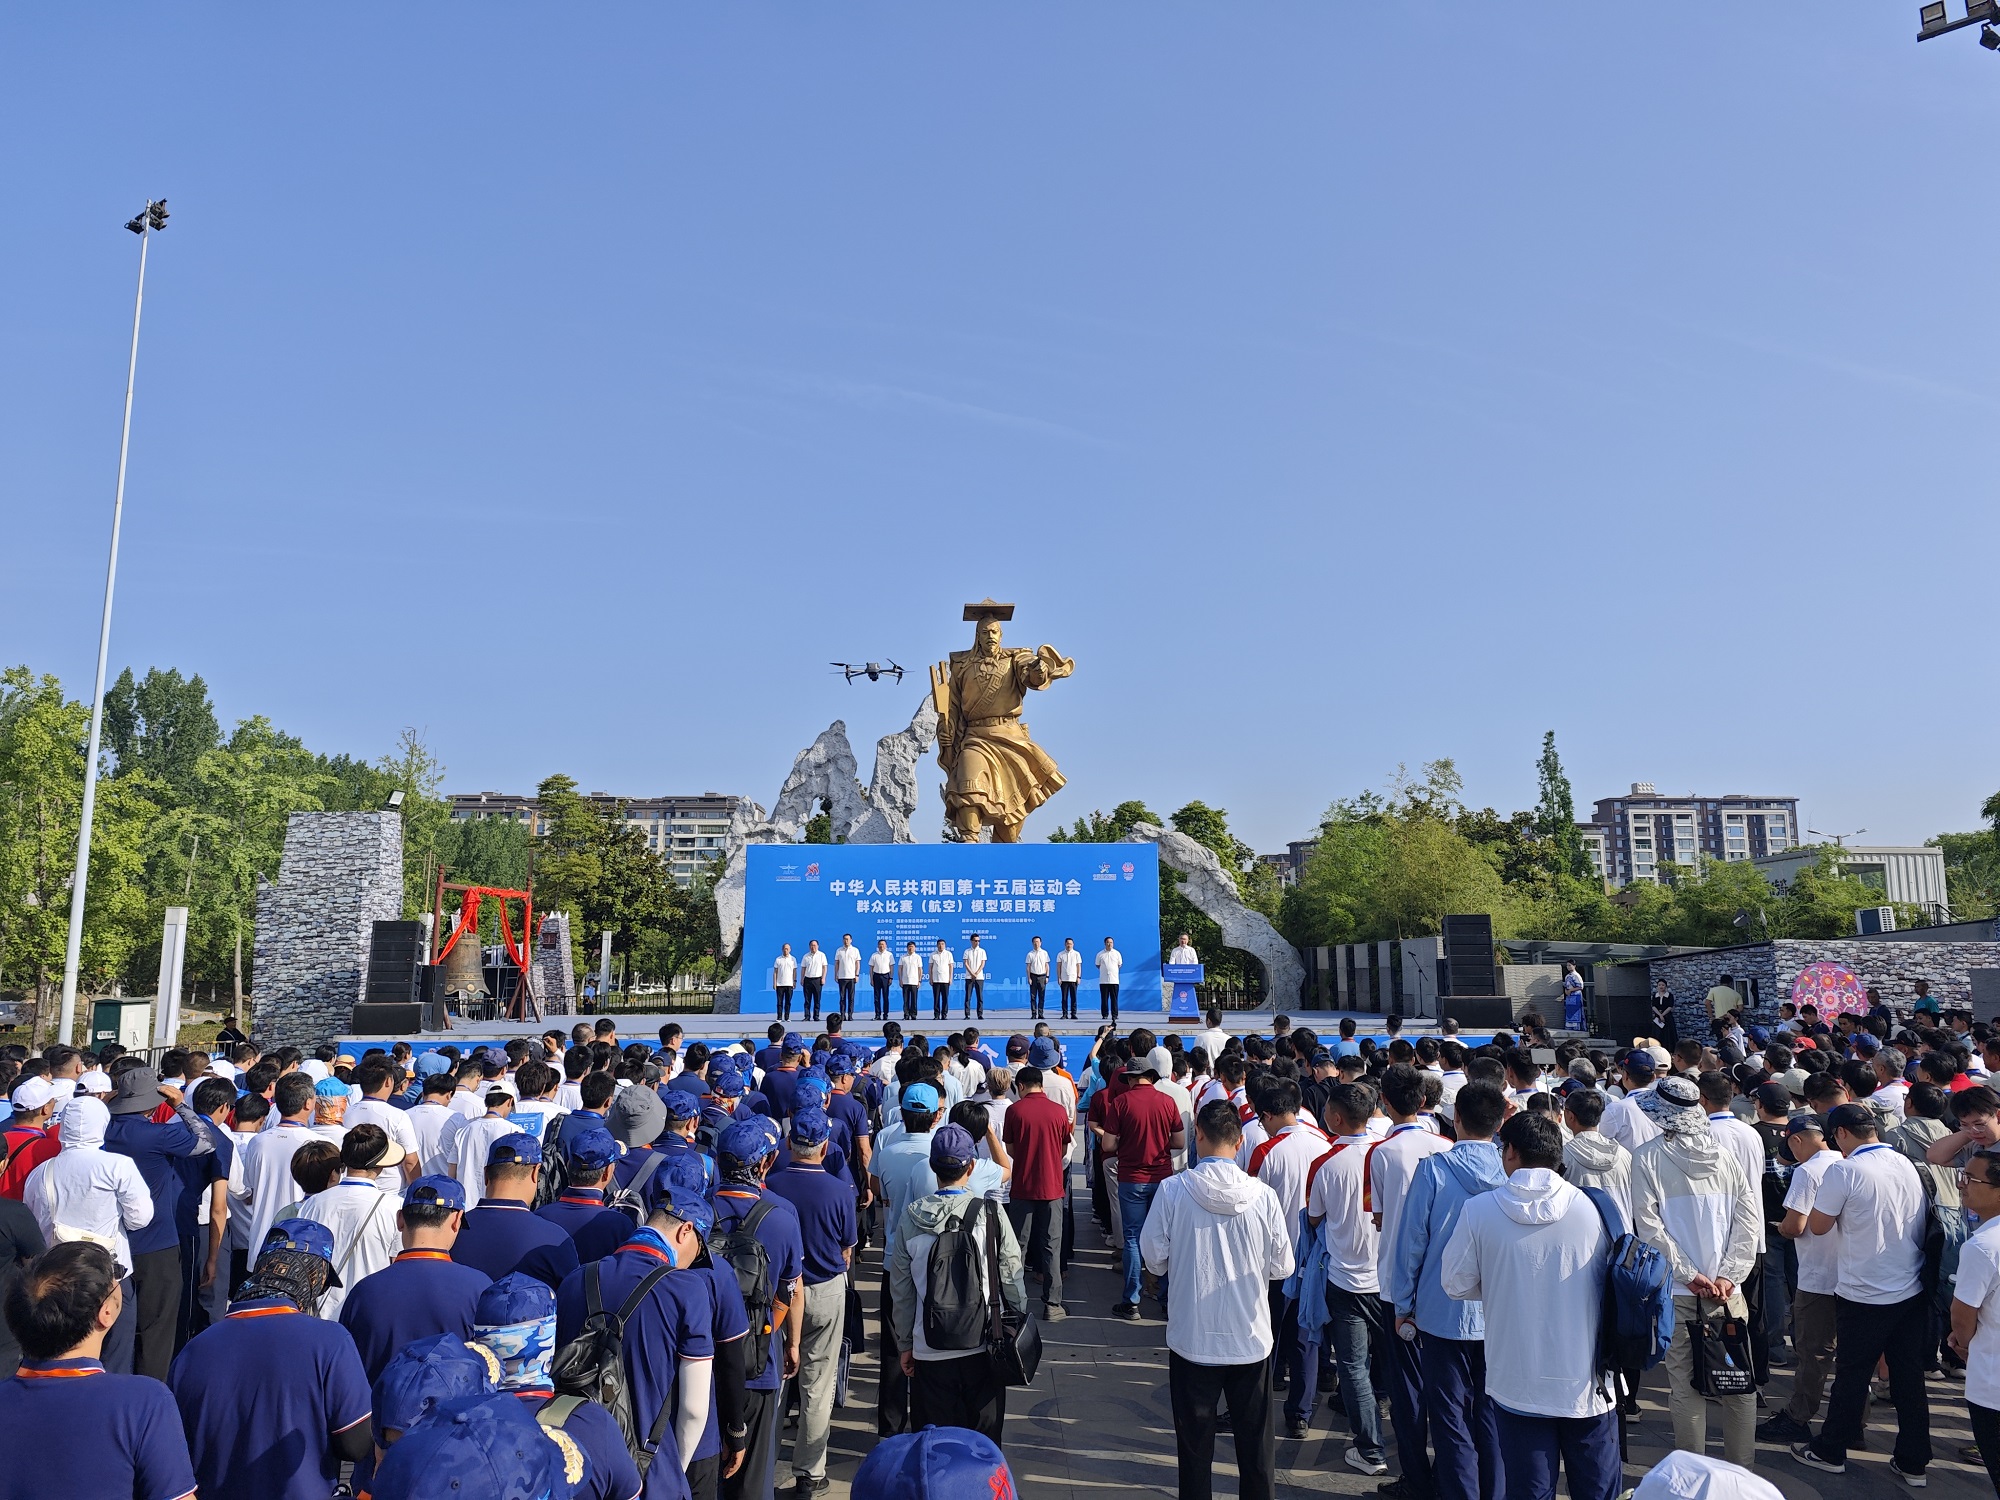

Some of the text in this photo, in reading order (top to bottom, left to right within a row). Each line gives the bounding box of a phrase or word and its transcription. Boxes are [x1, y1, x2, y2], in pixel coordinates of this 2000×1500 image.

[829, 879, 1082, 896] 中华人民共和国第十五届运动会
[856, 899, 1056, 913] 群众比赛（航空）模型项目预赛
